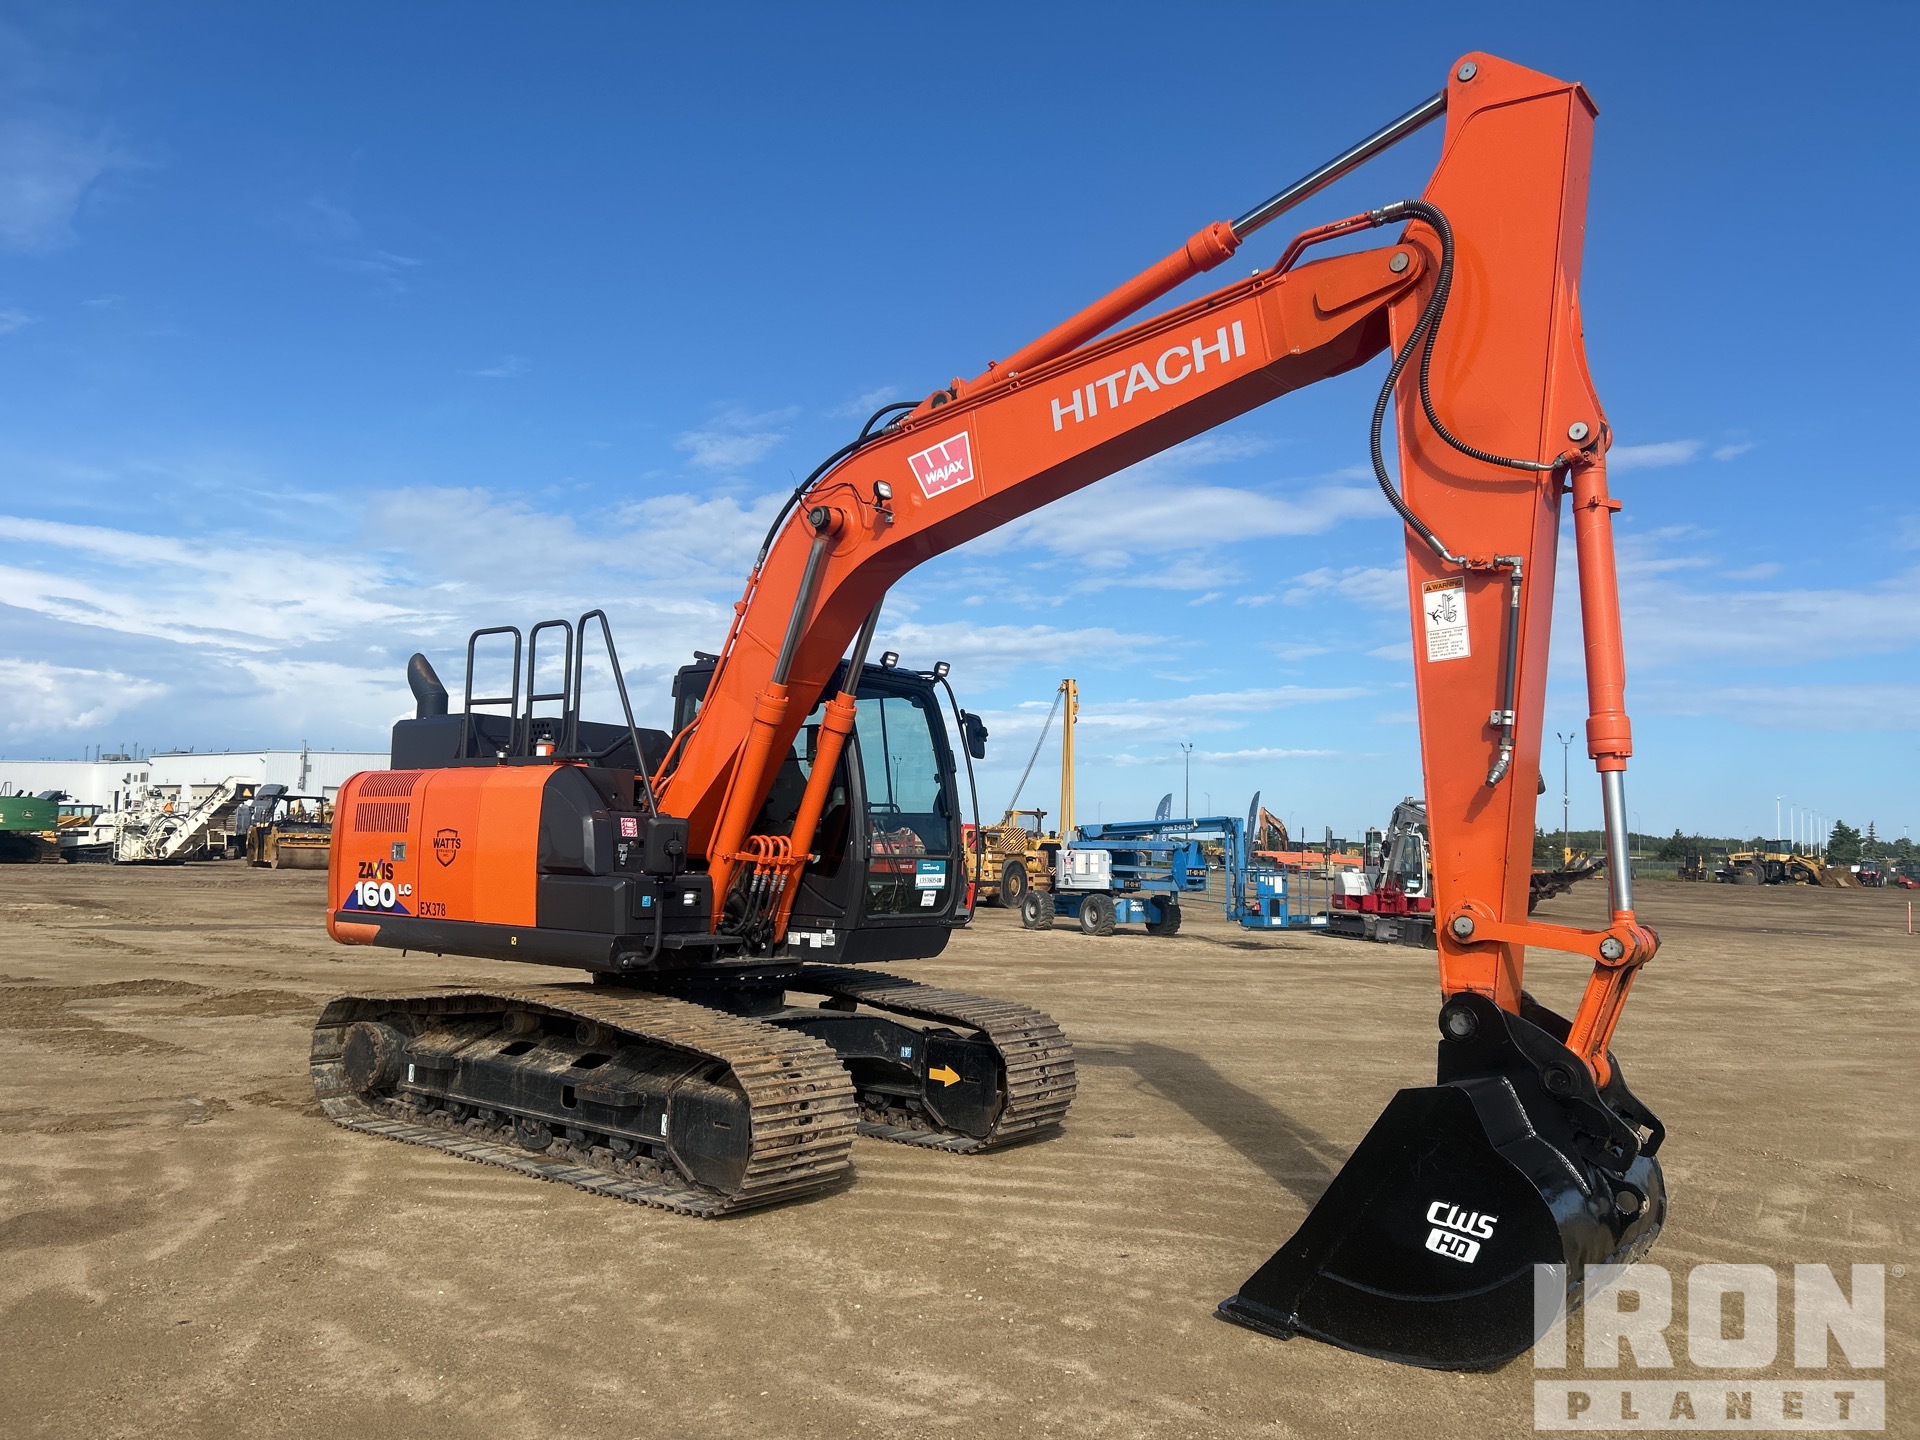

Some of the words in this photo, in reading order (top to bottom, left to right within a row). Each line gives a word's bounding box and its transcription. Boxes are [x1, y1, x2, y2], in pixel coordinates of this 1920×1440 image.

[1051, 320, 1246, 432] HITACHI
[925, 459, 964, 485] WAJAX
[1432, 580, 1462, 590] WARNING
[433, 838, 461, 849] WATTS
[358, 859, 393, 880] ZAXIS
[355, 881, 396, 909] 160
[398, 884, 412, 896] LC
[420, 902, 446, 916] EX378
[1427, 1201, 1498, 1239] CWS
[1436, 1234, 1470, 1258] HD
